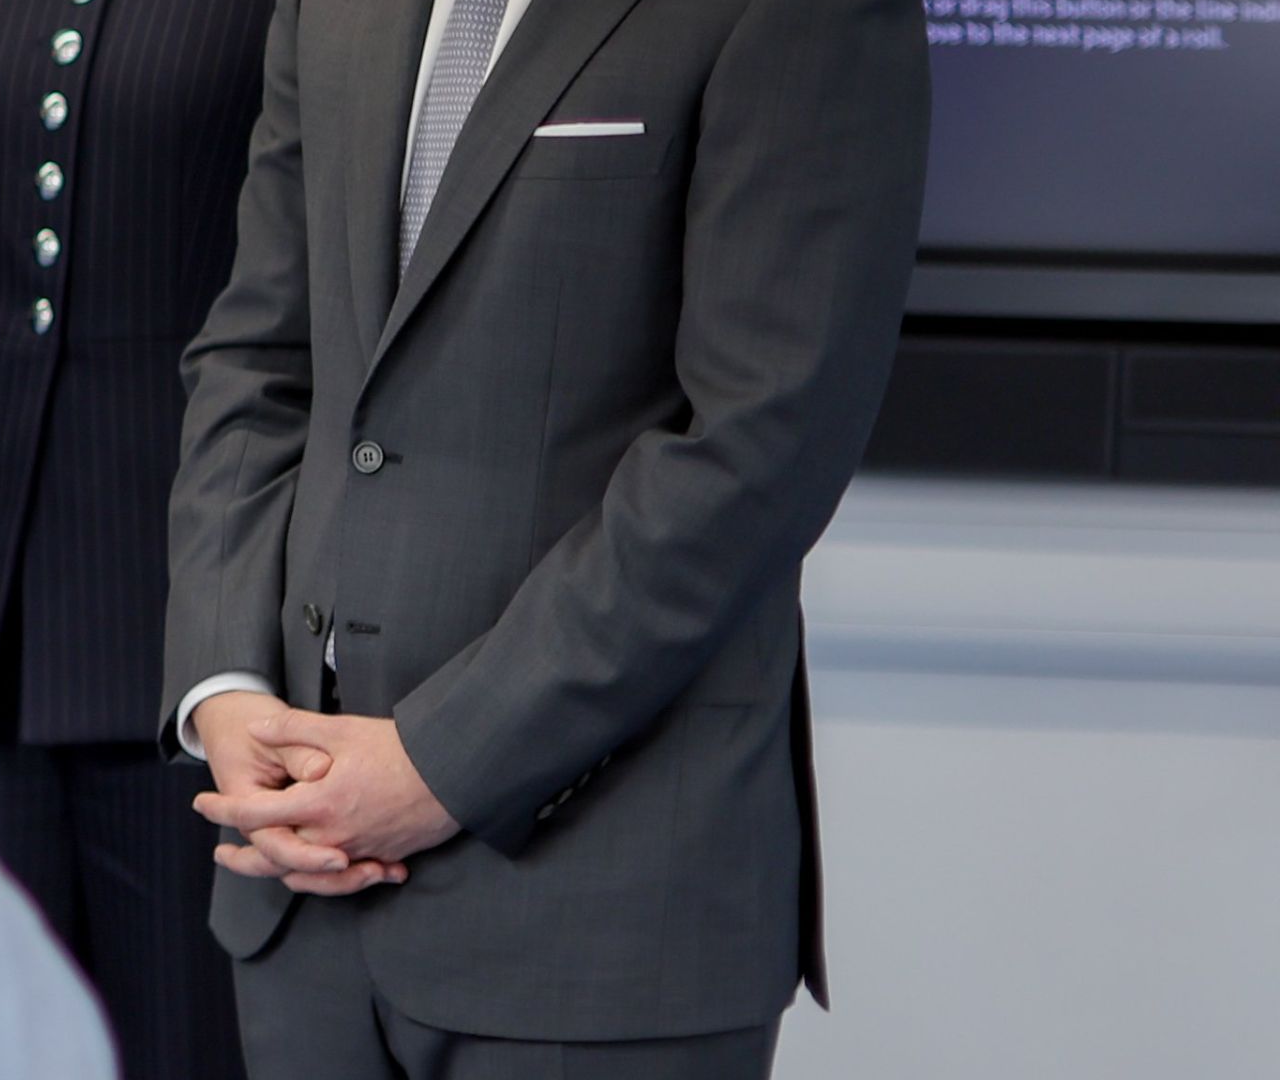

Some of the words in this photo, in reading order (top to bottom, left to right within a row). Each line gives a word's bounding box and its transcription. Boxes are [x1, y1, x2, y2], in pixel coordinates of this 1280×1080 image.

[927, 22, 965, 46] ove
[966, 21, 991, 46] to
[993, 21, 1031, 47] the
[1032, 23, 1082, 48] next
[1083, 25, 1136, 54] page
[1138, 23, 1163, 49] of
[1164, 27, 1180, 50] a
